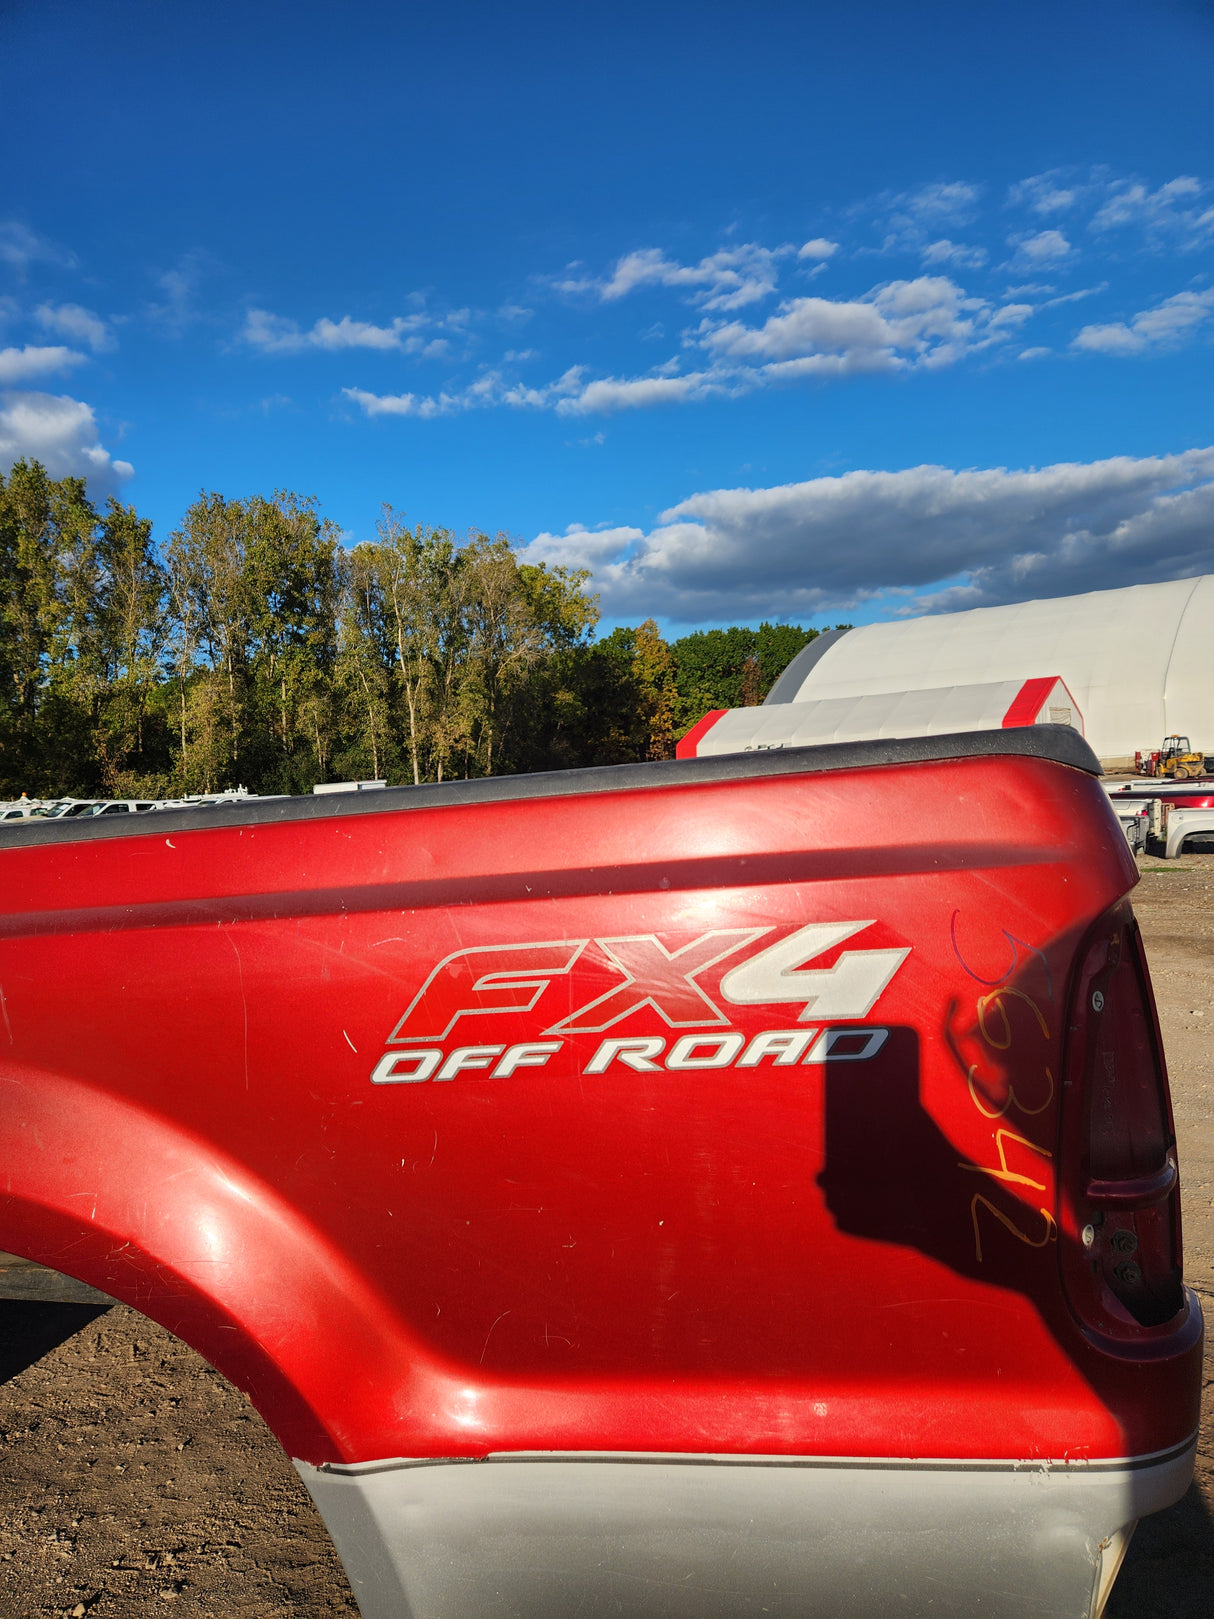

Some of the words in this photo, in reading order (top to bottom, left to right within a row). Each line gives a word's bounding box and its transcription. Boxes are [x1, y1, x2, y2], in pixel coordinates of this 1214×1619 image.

[386, 920, 912, 1044] FX4
[370, 1041, 563, 1084] OFF
[583, 1027, 891, 1074] ROAD
[950, 908, 1057, 1263] 56342
